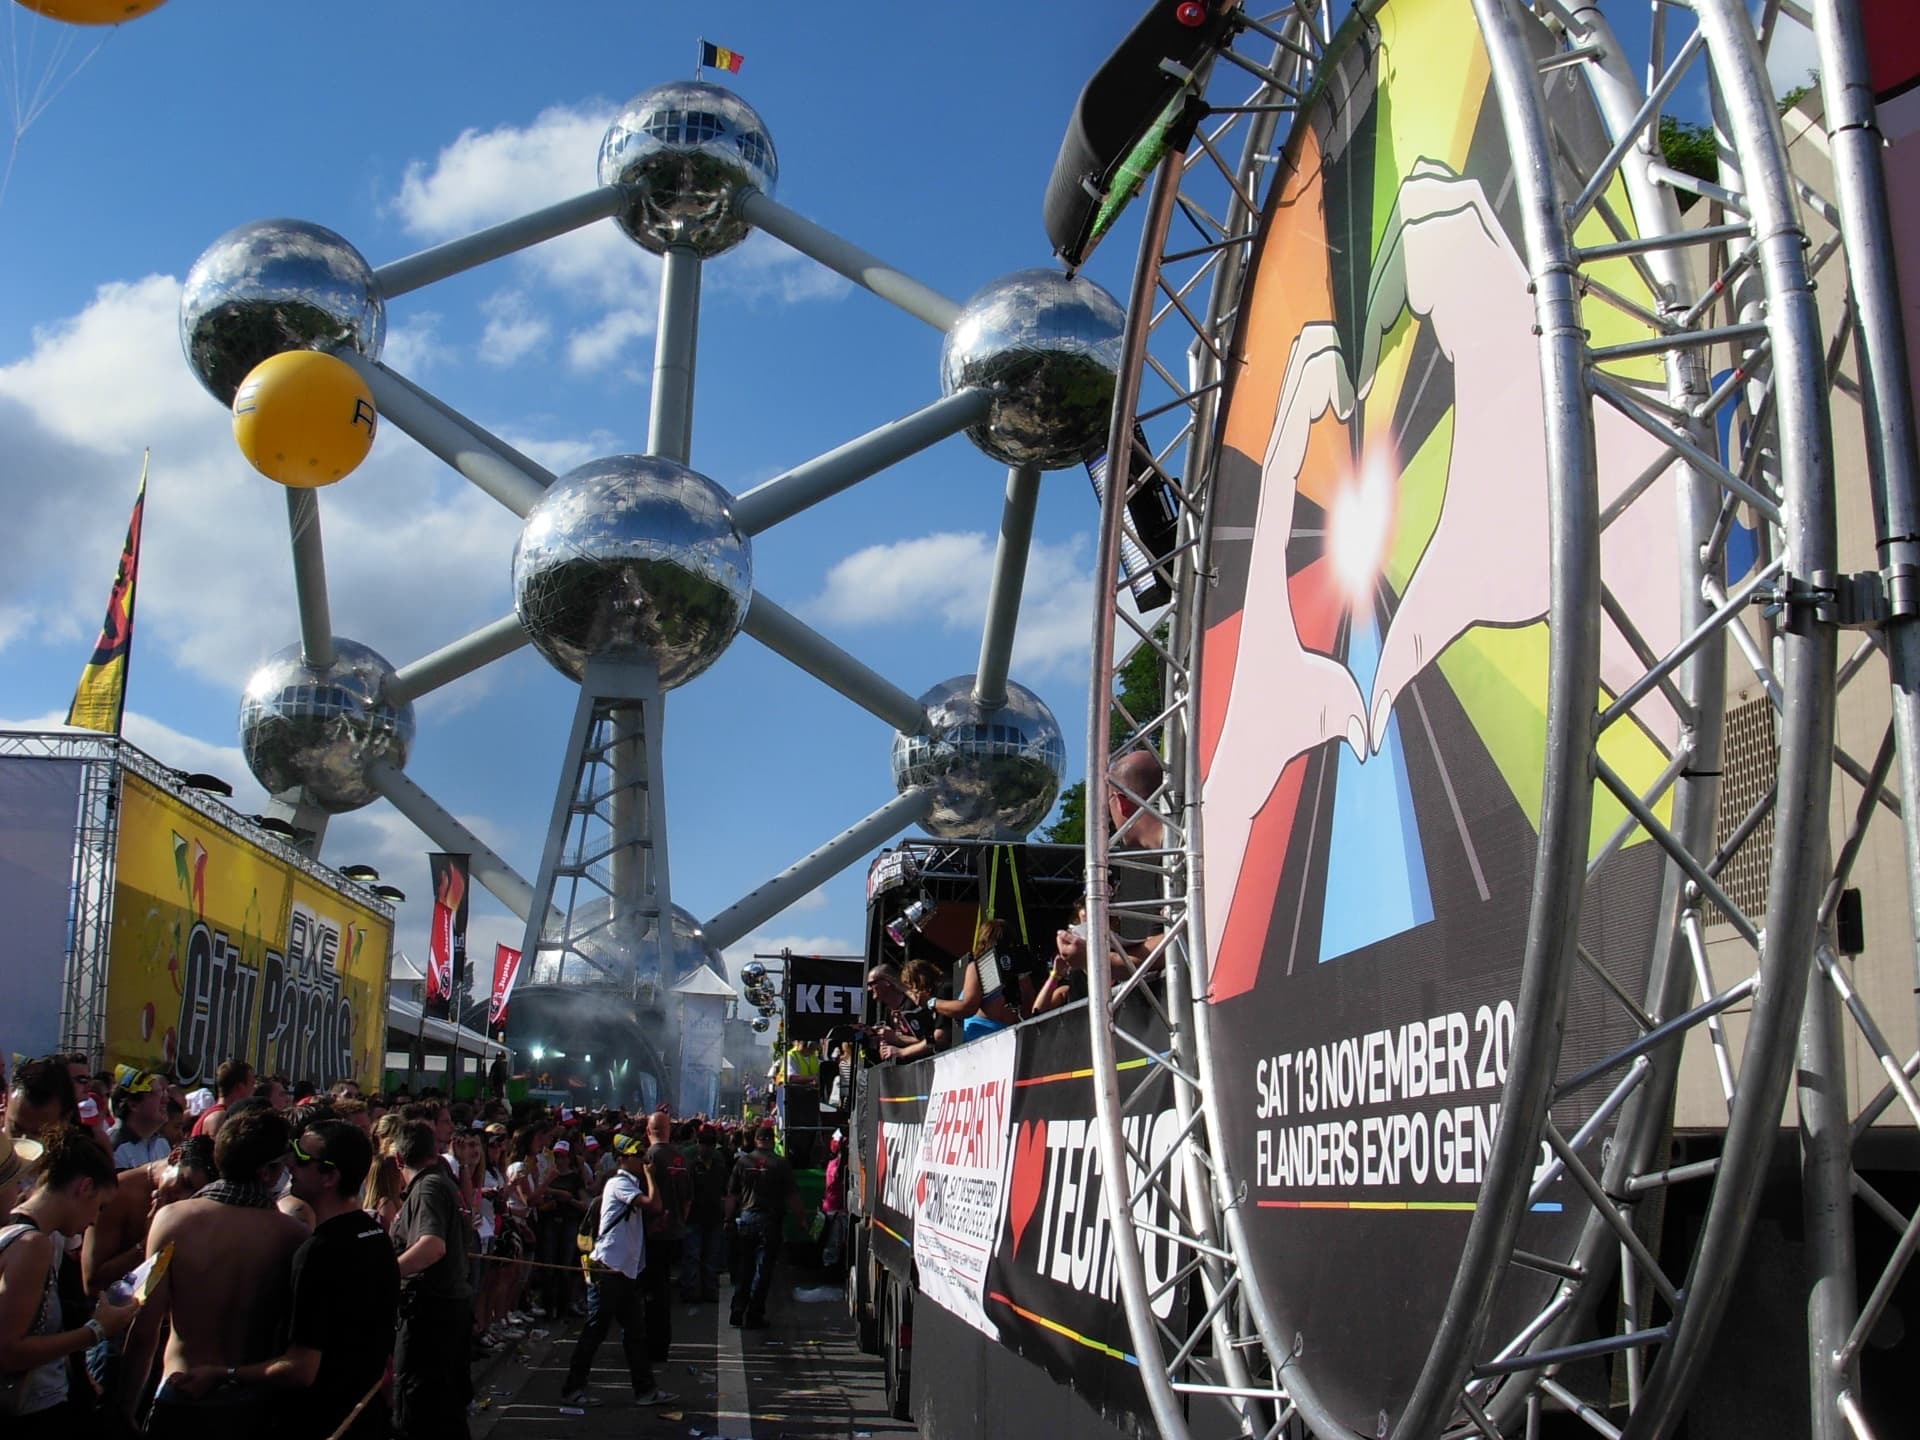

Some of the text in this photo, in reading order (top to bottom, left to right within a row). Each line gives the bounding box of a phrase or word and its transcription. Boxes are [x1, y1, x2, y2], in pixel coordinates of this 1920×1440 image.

[176, 920, 260, 1086] City
[498, 952, 513, 989] Jupiler
[1256, 1053, 1292, 1119] SAT
[1295, 1047, 1319, 1113] 13
[1321, 1011, 1471, 1110] NOVEMBER
[932, 1079, 1006, 1169] PREPARTY
[1256, 1119, 1358, 1187] FLANDERS
[1362, 1111, 1430, 1186] EXPO
[1434, 1103, 1501, 1184] GEN
